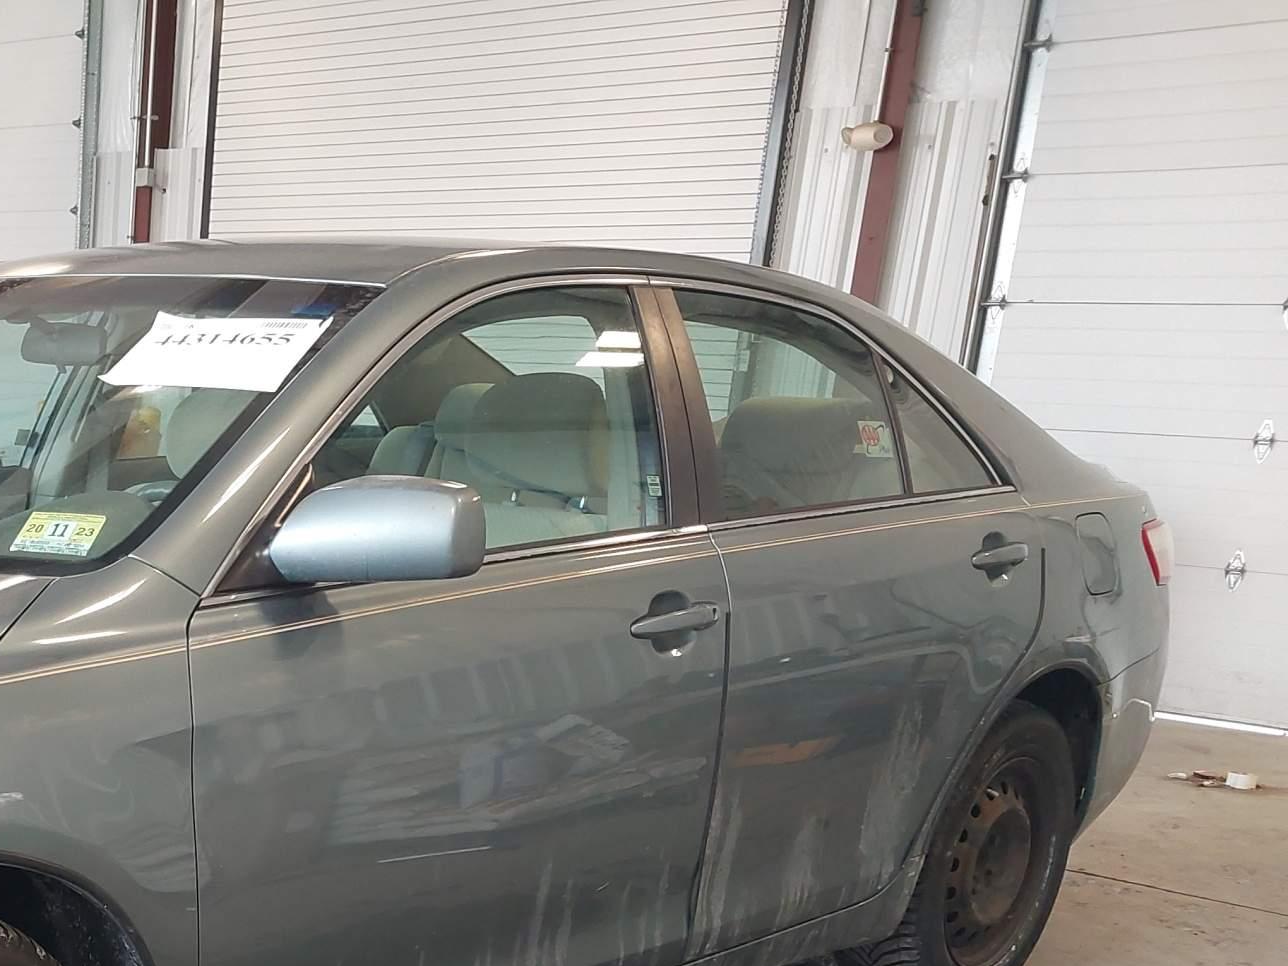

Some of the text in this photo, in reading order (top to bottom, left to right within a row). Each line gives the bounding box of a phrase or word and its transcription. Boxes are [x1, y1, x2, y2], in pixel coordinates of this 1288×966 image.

[155, 333, 296, 346] 44314655
[26, 523, 95, 538] 20 11 23
